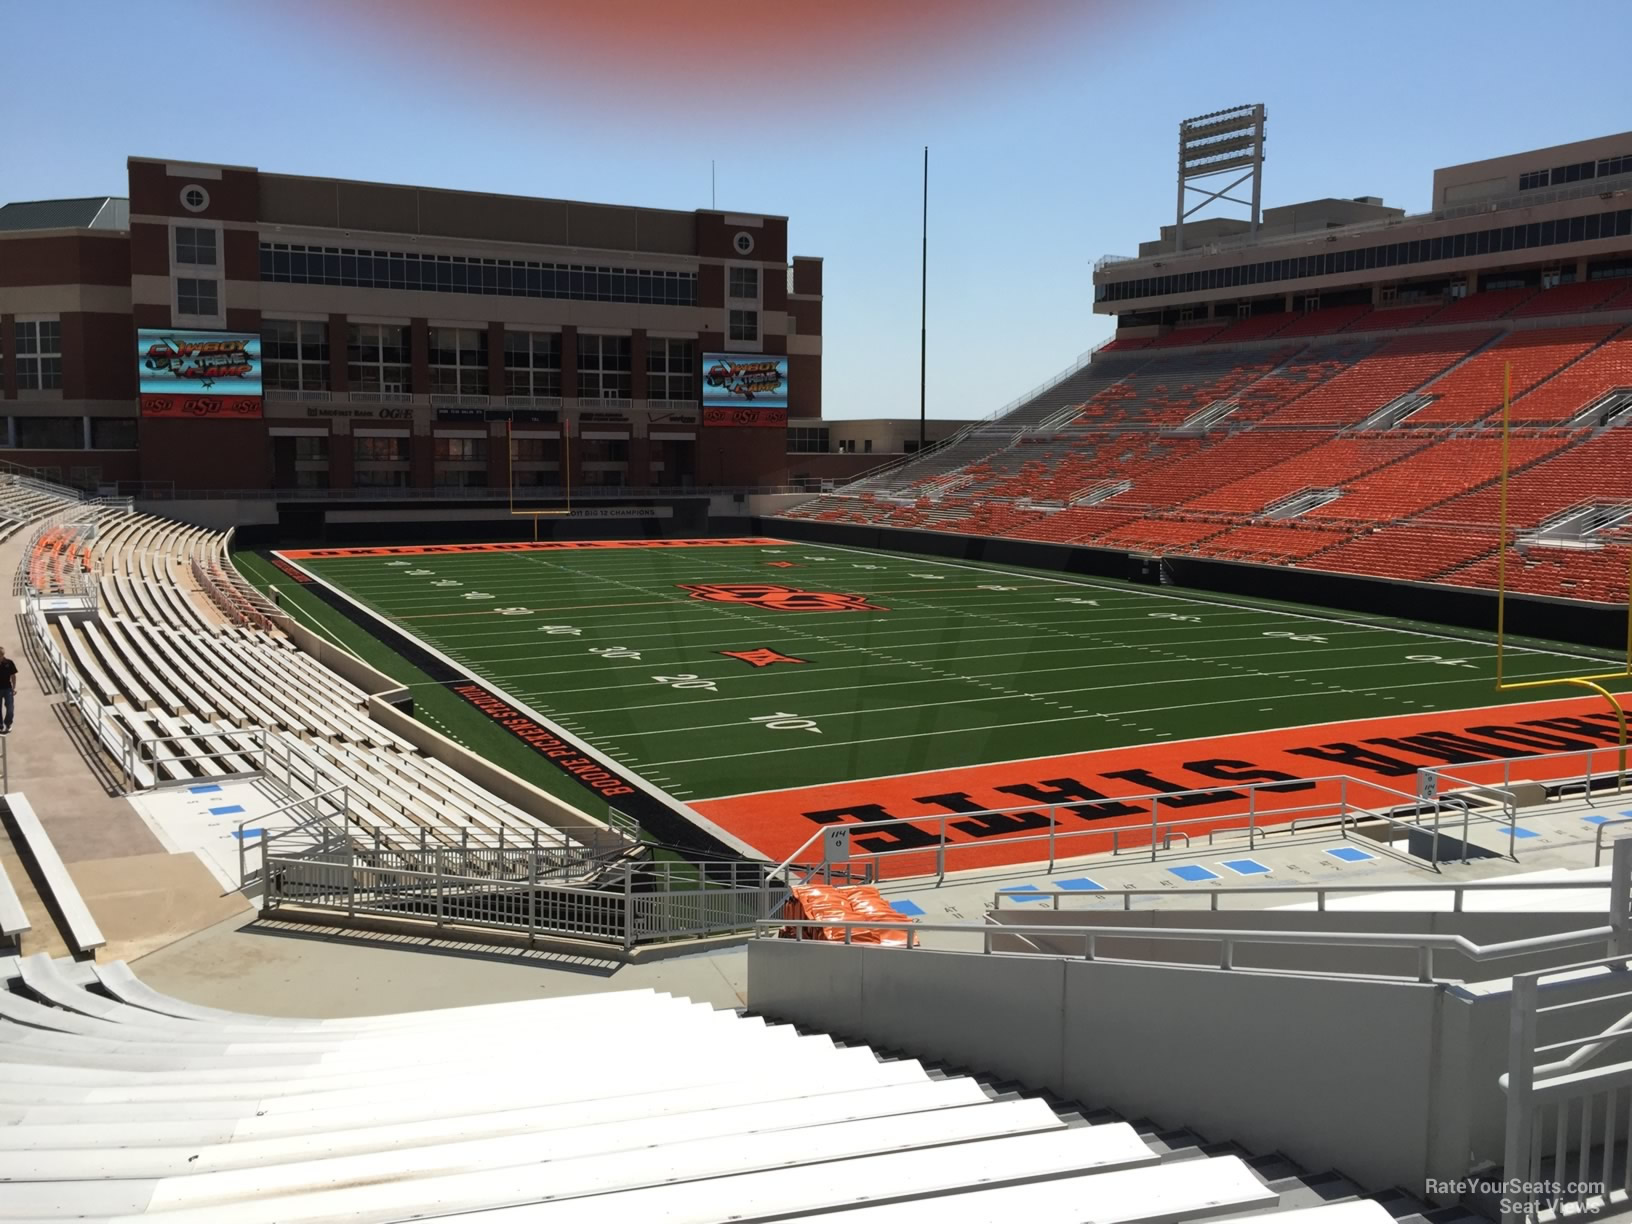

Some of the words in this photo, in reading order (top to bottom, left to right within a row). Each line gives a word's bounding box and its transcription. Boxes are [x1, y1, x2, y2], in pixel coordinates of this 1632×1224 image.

[183, 398, 223, 416] OSU
[609, 509, 654, 517] CHAMPIONS
[588, 645, 634, 659] 30
[650, 673, 716, 690] 20
[453, 684, 518, 718] STADIUM
[748, 711, 817, 730] 10
[502, 717, 577, 758] PICKENS
[560, 757, 635, 797] BOONE
[805, 757, 1315, 853] STATE
[830, 830, 846, 838] 114
